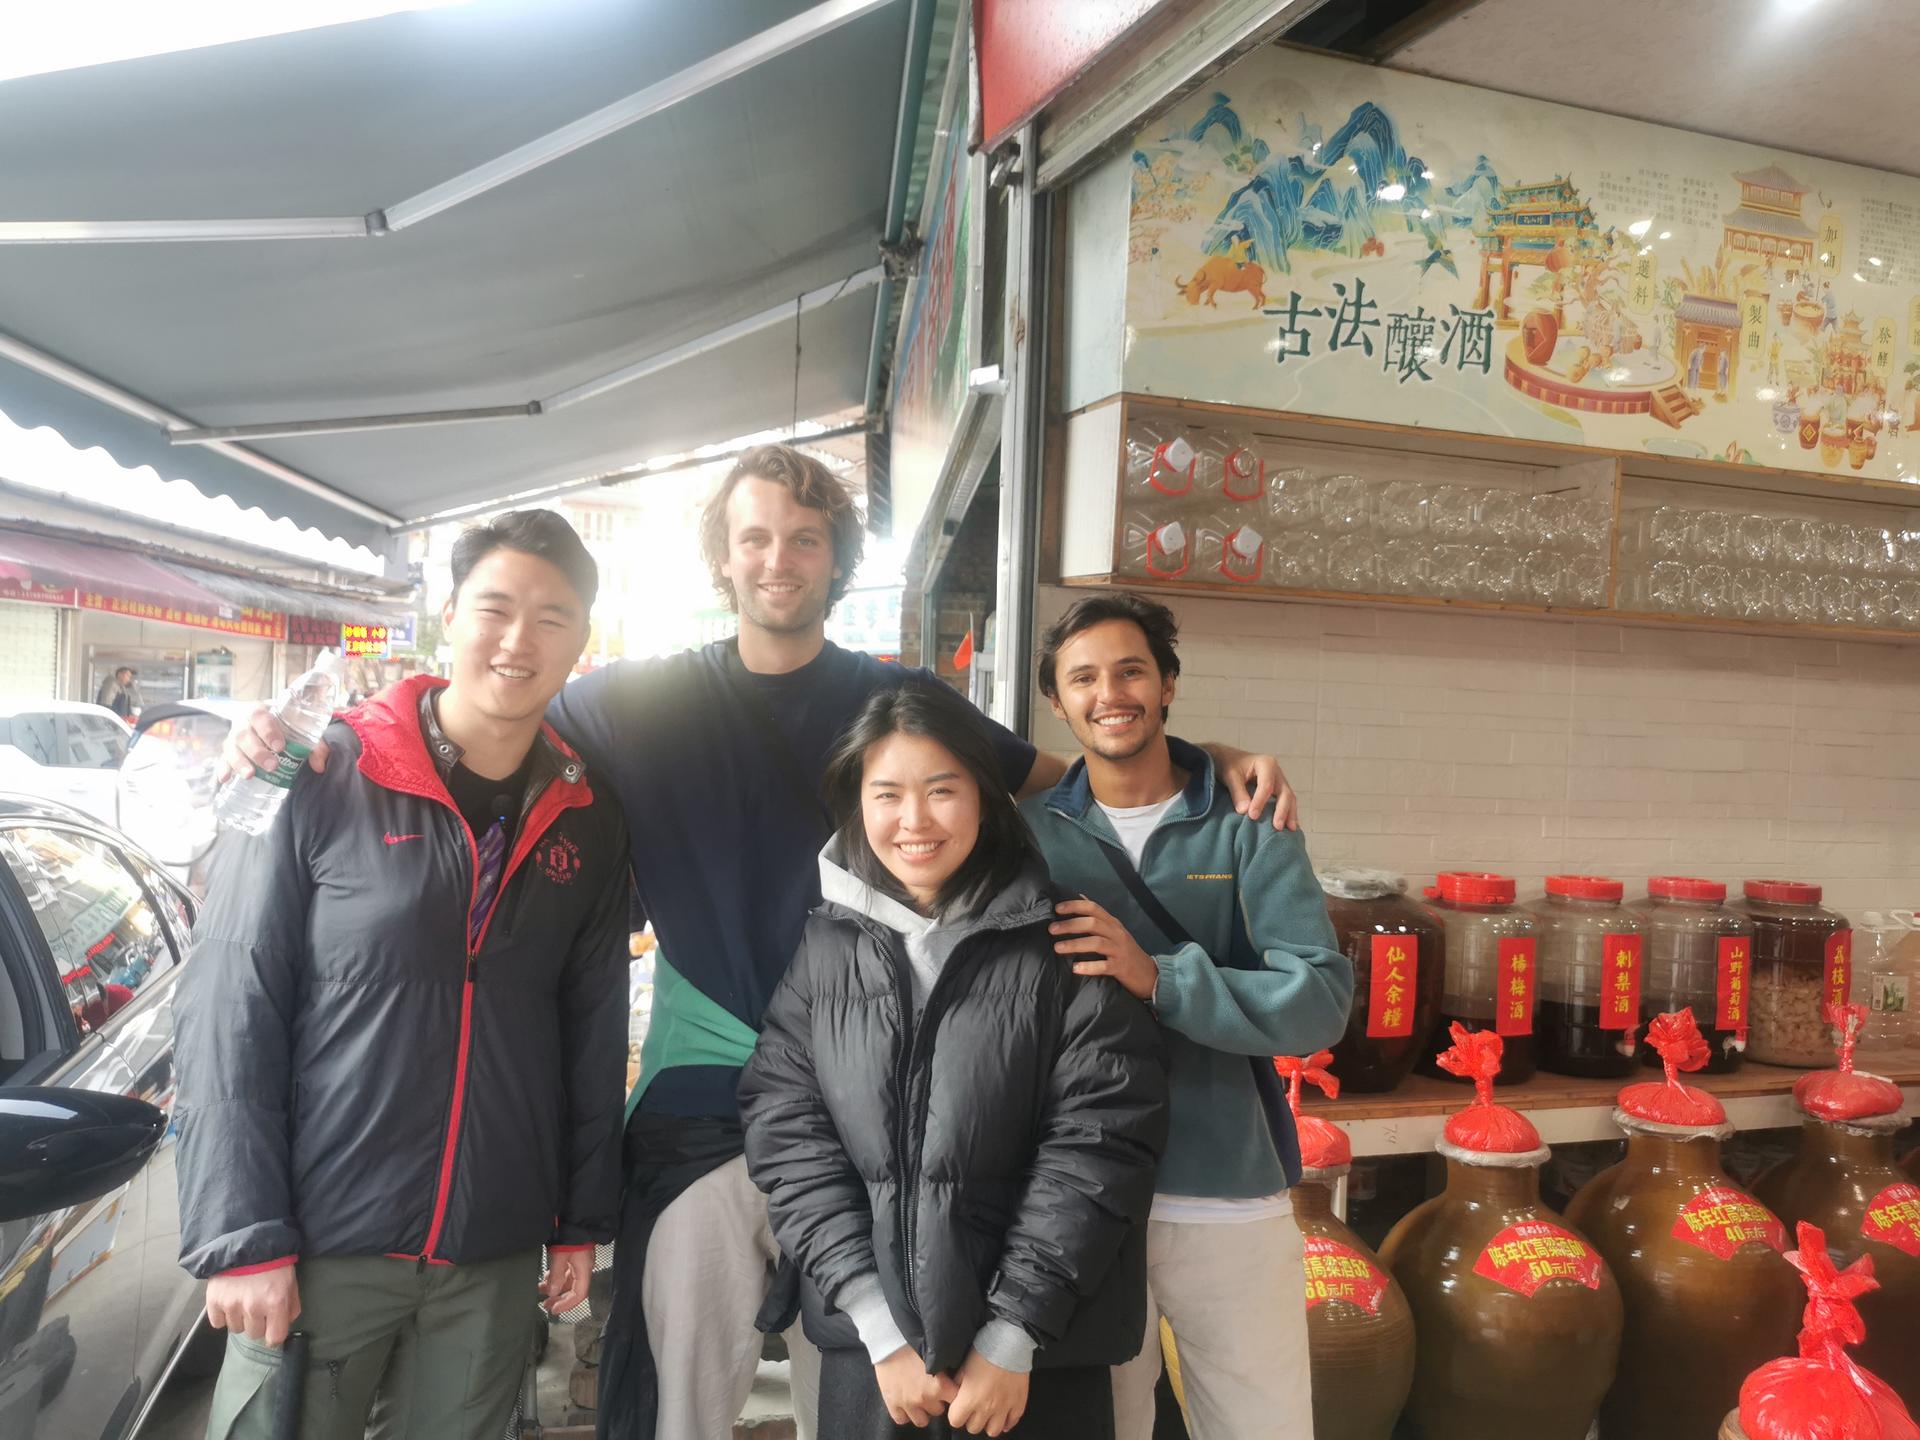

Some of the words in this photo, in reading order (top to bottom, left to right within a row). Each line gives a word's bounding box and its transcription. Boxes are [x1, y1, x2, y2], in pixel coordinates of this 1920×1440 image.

[1614, 950, 1632, 1013] 刺梨酒
[1528, 1260, 1577, 1280] 50元/斤
